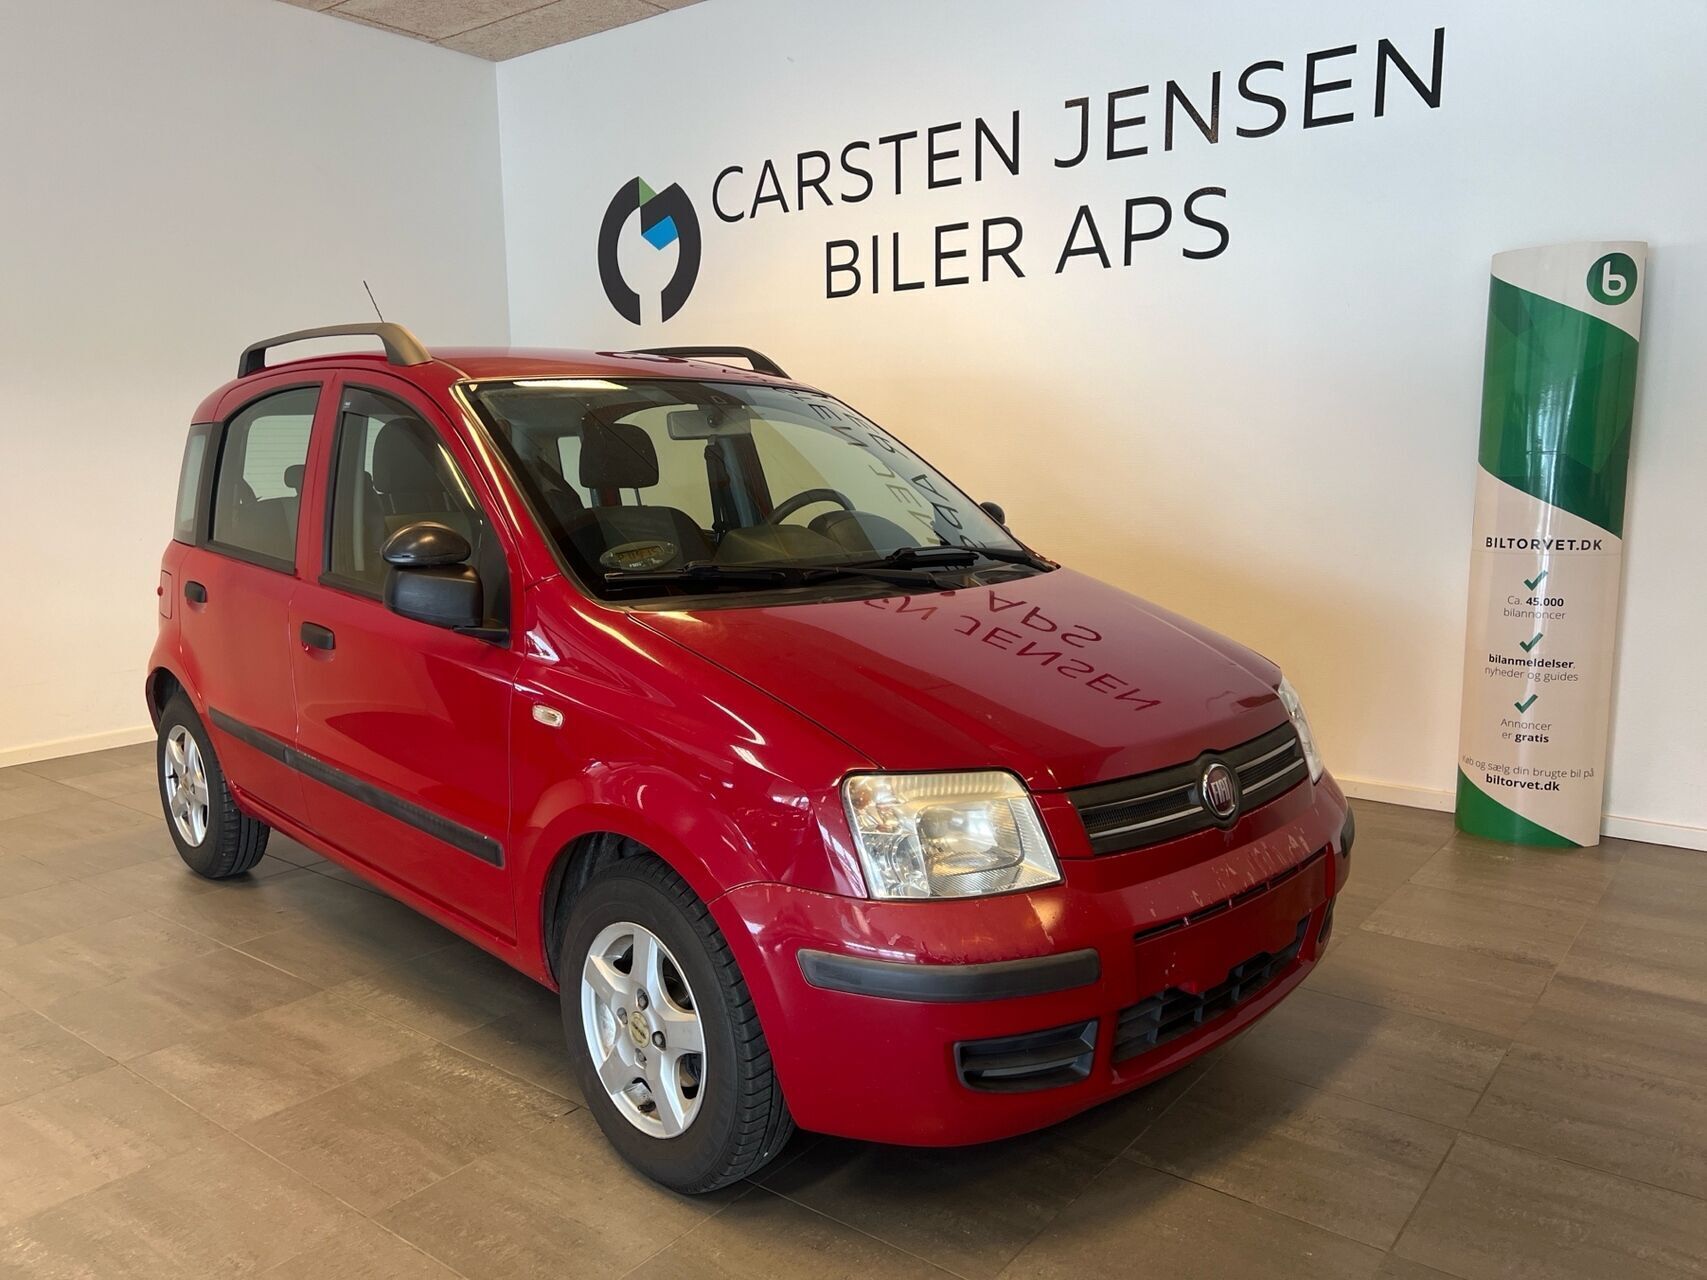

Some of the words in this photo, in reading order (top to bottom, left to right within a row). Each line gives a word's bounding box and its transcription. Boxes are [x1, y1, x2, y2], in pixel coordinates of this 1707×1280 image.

[712, 110, 1020, 223] CARSTEN
[1054, 27, 1445, 168] JENSEN
[826, 216, 1026, 299] BILER
[1055, 186, 1230, 274] APS
[1602, 260, 1627, 297] b
[1485, 536, 1602, 551] BILTORVET.DK
[1507, 595, 1523, 606] Ca.
[1525, 596, 1564, 607] 45.000
[1503, 607, 1566, 620] bilannoncer
[1484, 666, 1525, 679] nyheder
[1527, 671, 1541, 683] og
[1543, 671, 1579, 683] guides
[1500, 718, 1552, 731] Annoncer
[1502, 731, 1513, 740] er
[1514, 733, 1550, 743] gratis
[1475, 760, 1486, 771] og
[1487, 762, 1511, 775] sælg
[1513, 766, 1530, 776] din
[1532, 767, 1568, 779] brugte
[1570, 769, 1582, 778] bil
[1583, 767, 1595, 779] på
[1486, 773, 1561, 791] biltorvet.dk
